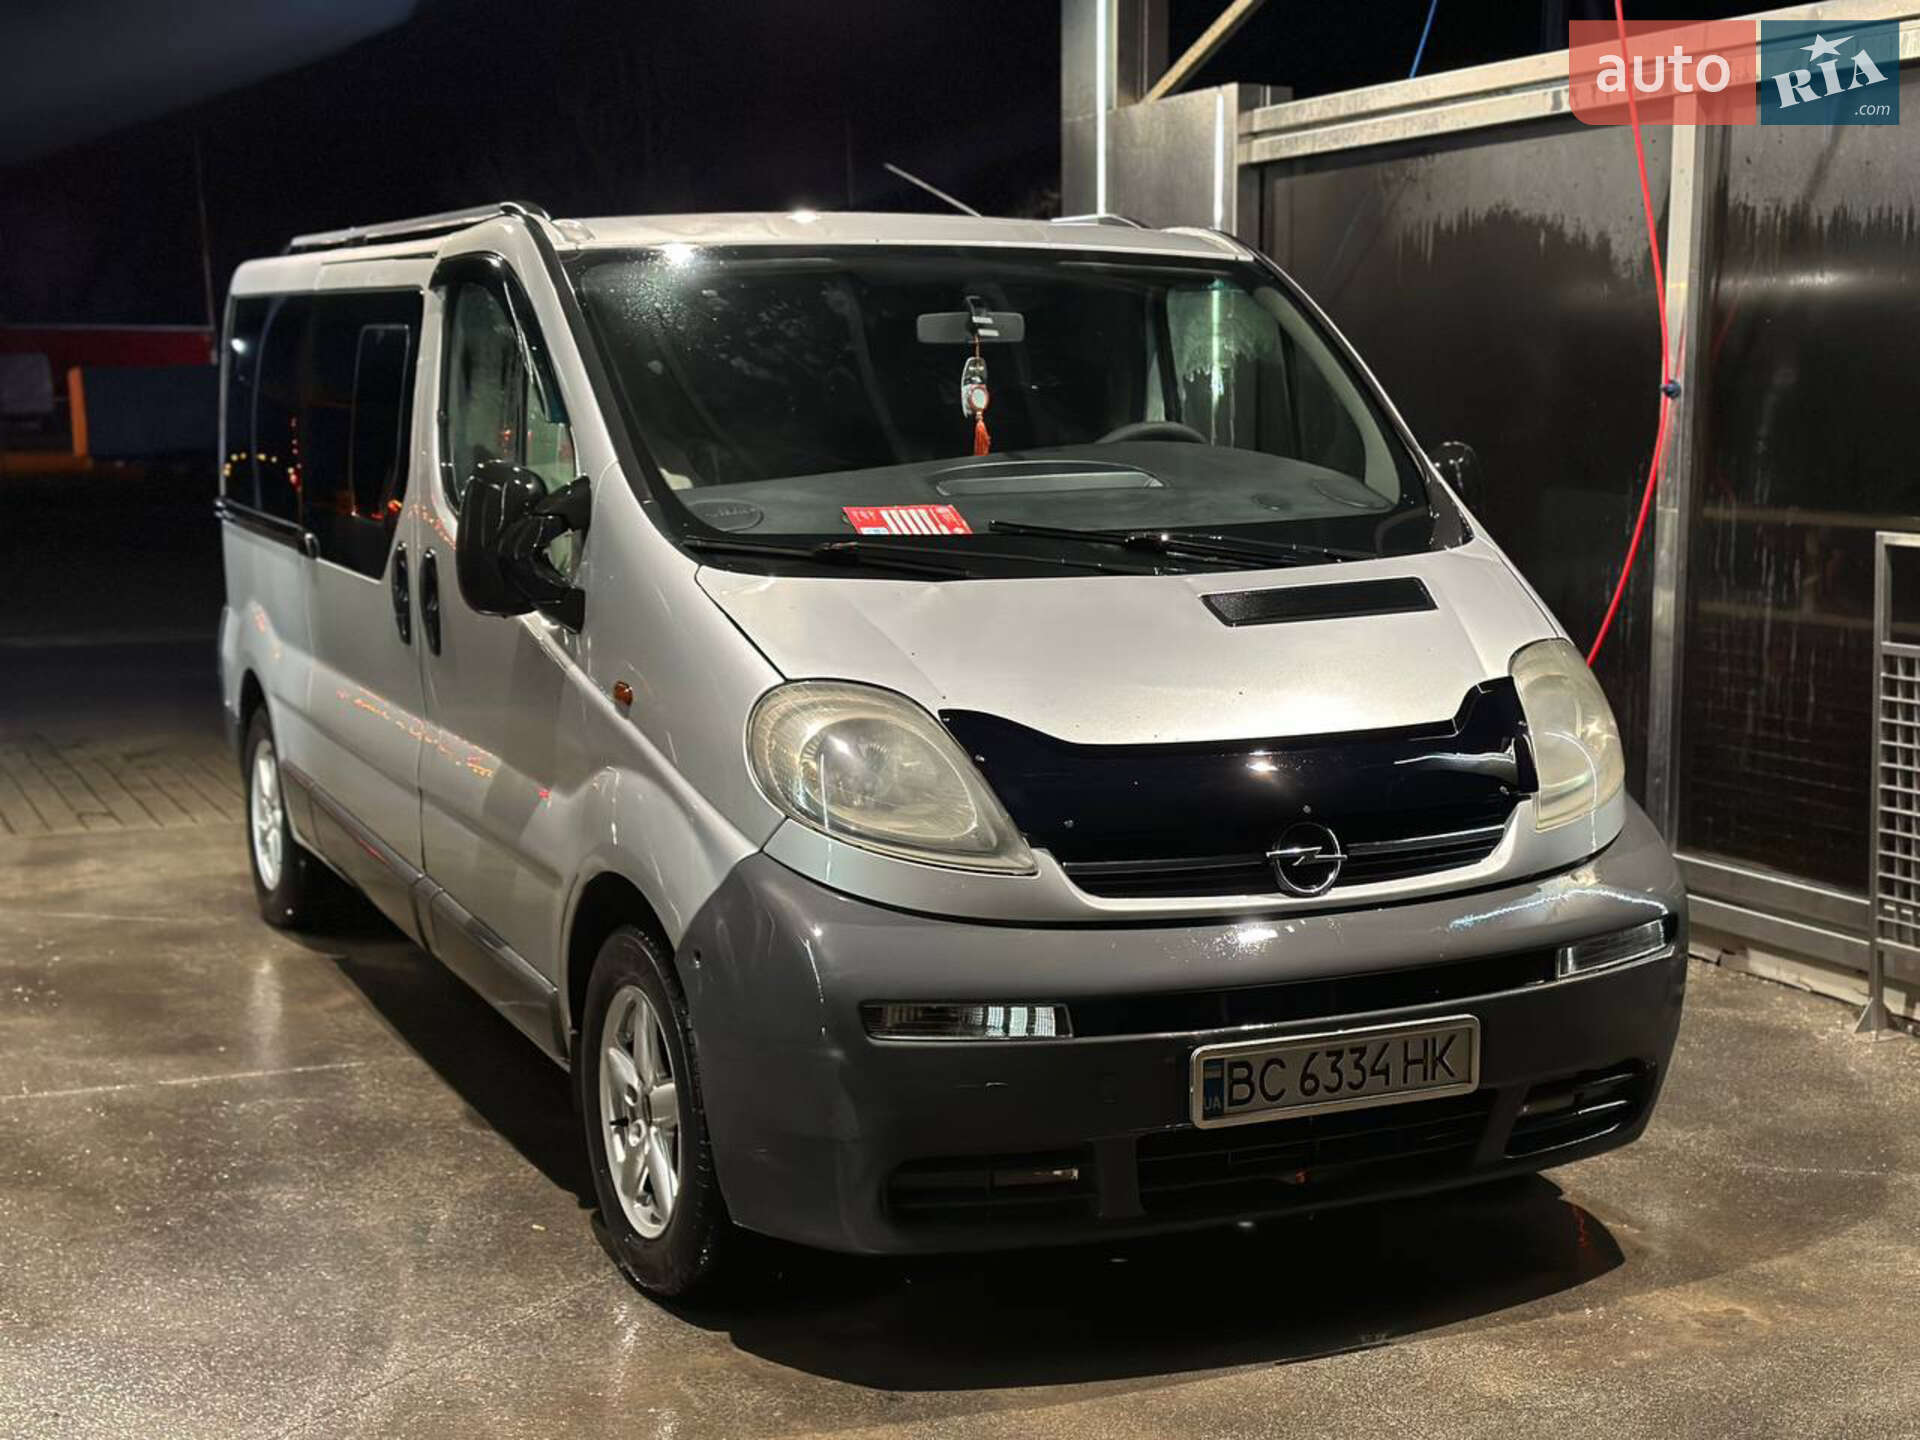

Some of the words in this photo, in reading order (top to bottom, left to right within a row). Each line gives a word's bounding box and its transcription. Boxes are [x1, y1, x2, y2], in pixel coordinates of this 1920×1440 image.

[1226, 1058, 1286, 1107] BC
[1300, 1042, 1390, 1097] 6334
[1403, 1034, 1457, 1084] HK
